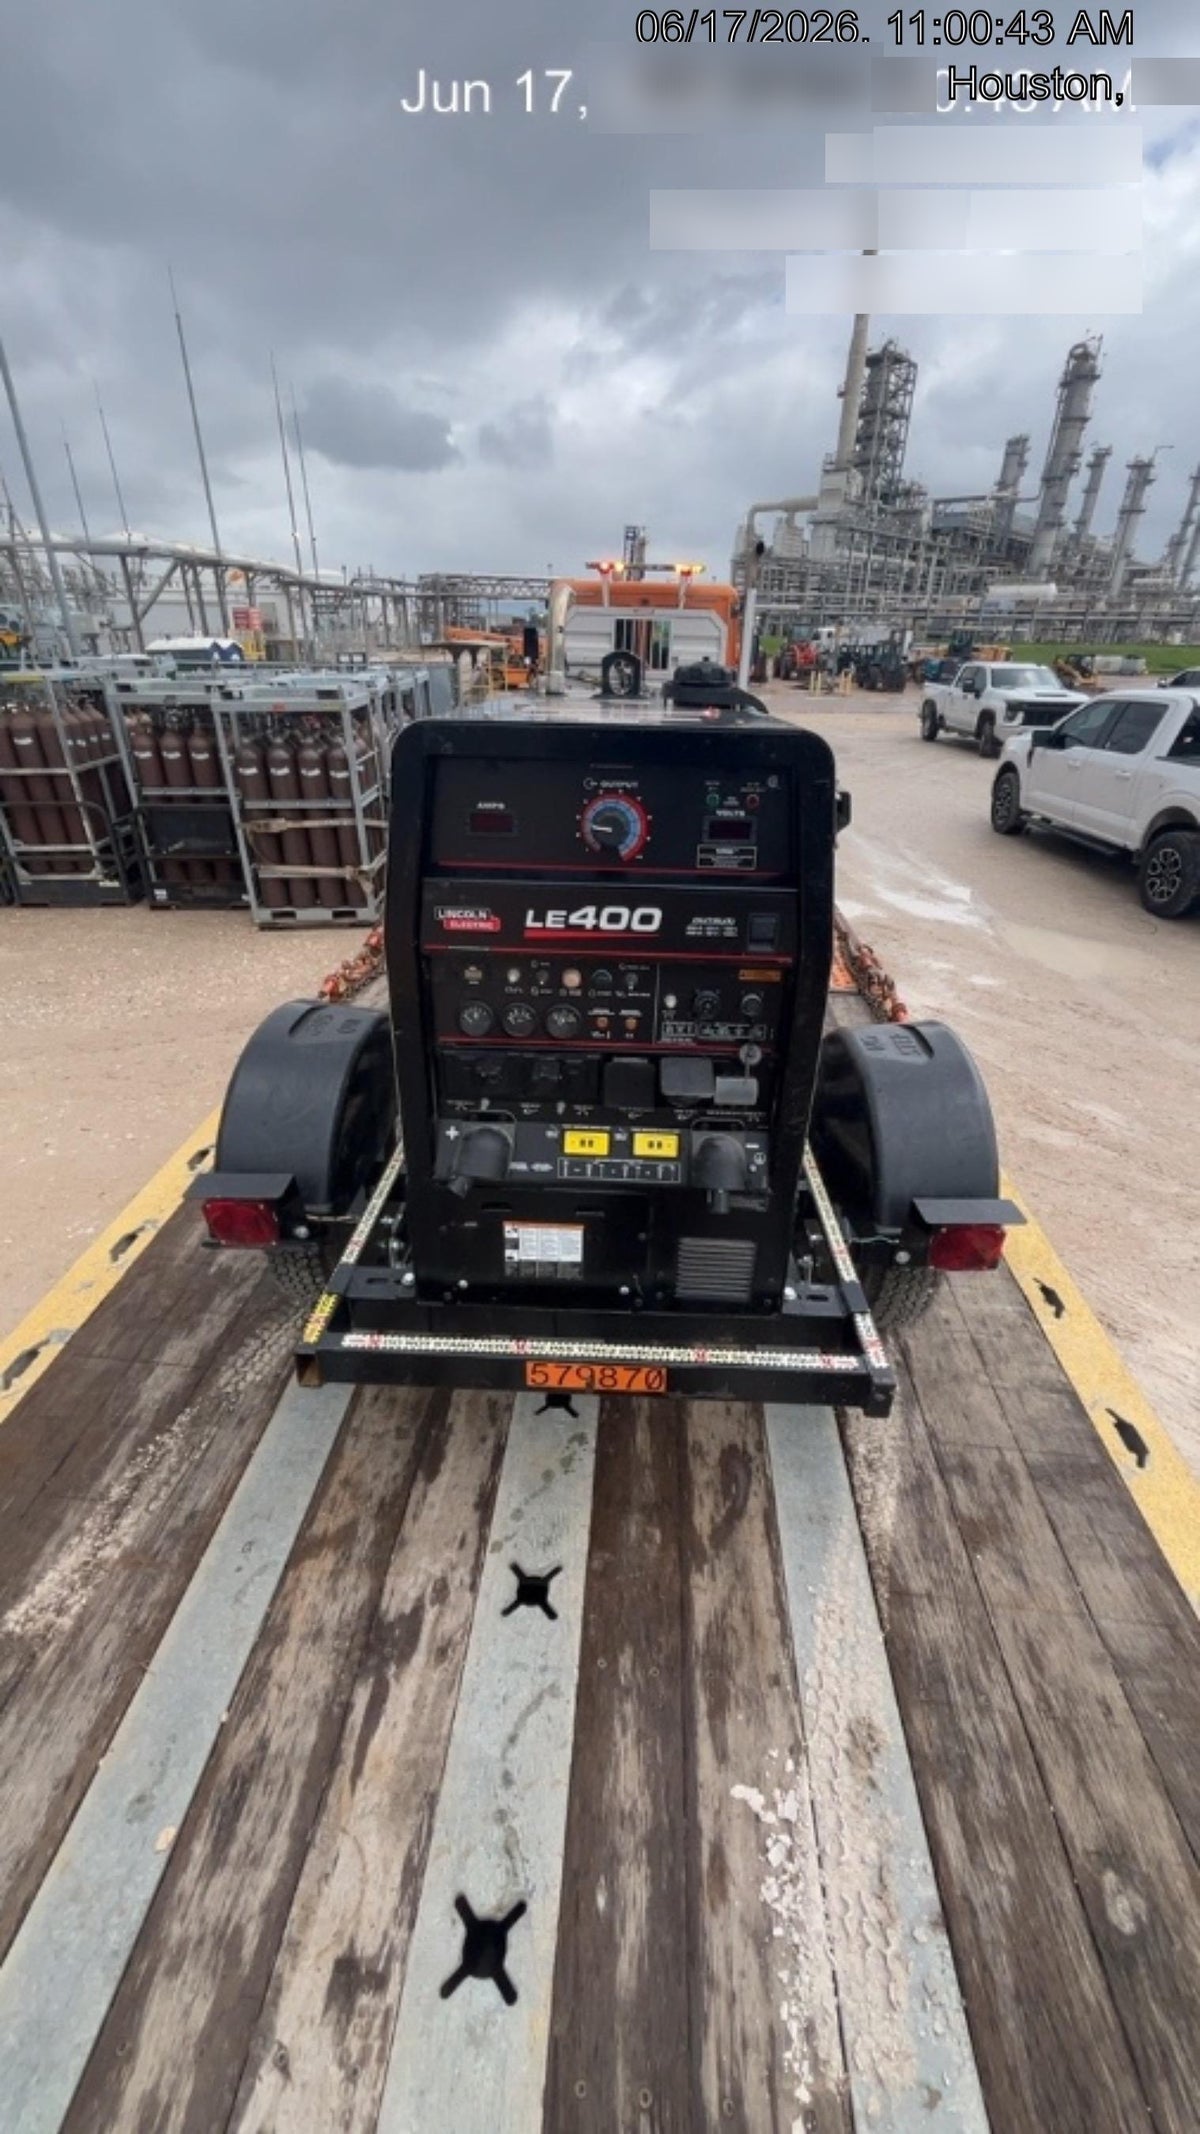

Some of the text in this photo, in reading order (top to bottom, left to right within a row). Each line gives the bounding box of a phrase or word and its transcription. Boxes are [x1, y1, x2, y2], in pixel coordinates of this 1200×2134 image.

[438, 909, 488, 920] LINCOLN
[525, 905, 663, 932] LE400
[530, 1362, 663, 1390] 579870
